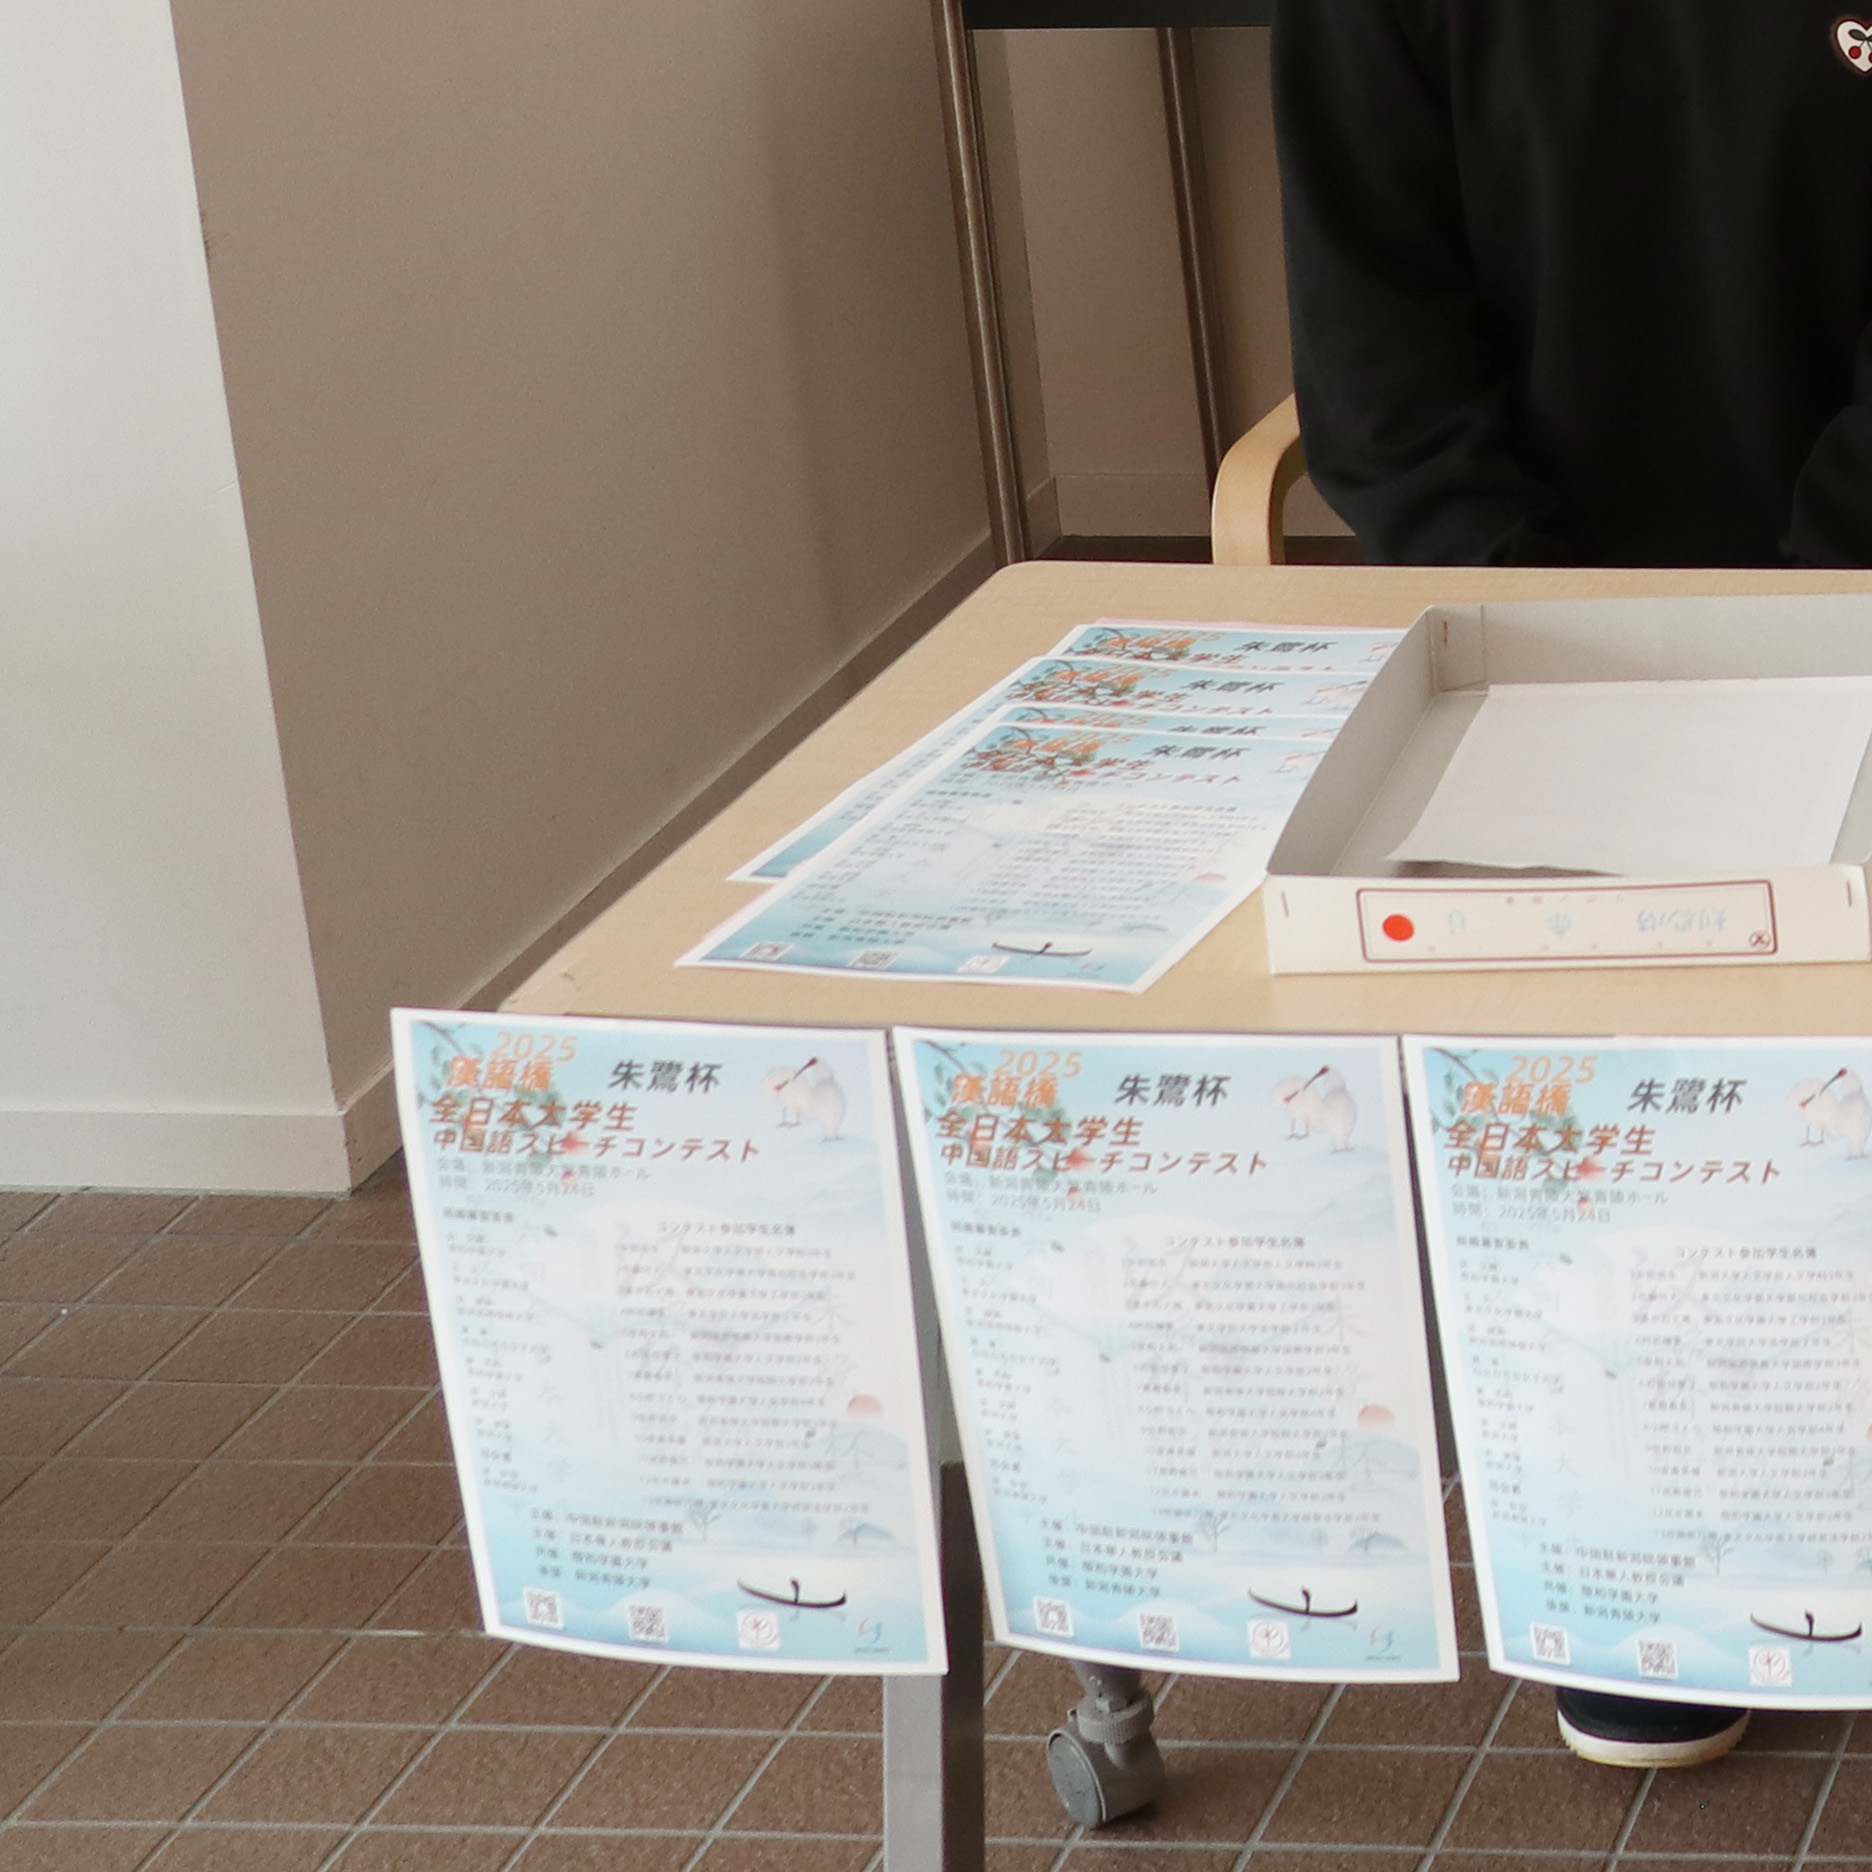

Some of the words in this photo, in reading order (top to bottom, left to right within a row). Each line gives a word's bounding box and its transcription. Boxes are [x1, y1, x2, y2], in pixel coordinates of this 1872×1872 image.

[490, 1032, 578, 1061] 2025
[994, 1050, 1082, 1077] 2025
[447, 1058, 553, 1092] 漢語橋
[609, 1058, 721, 1095] 朱鷺杯
[1506, 1056, 1597, 1083] 2025
[952, 1075, 1057, 1108] 漢語橋
[1115, 1073, 1230, 1108] 朱鷺杯
[1461, 1083, 1570, 1116] 漢語橋
[1628, 1079, 1745, 1114] 朱鷺杯
[429, 1096, 636, 1133] 全日本大学生
[936, 1113, 1142, 1148] 全日本大学生
[434, 1128, 760, 1165] 中国語スピーチコンテスト
[1443, 1122, 1655, 1157] 全日本大学生
[941, 1143, 1268, 1178] 中国語スピーチコンテスト
[1448, 1154, 1782, 1186] 中国語スピーチコンテスト
